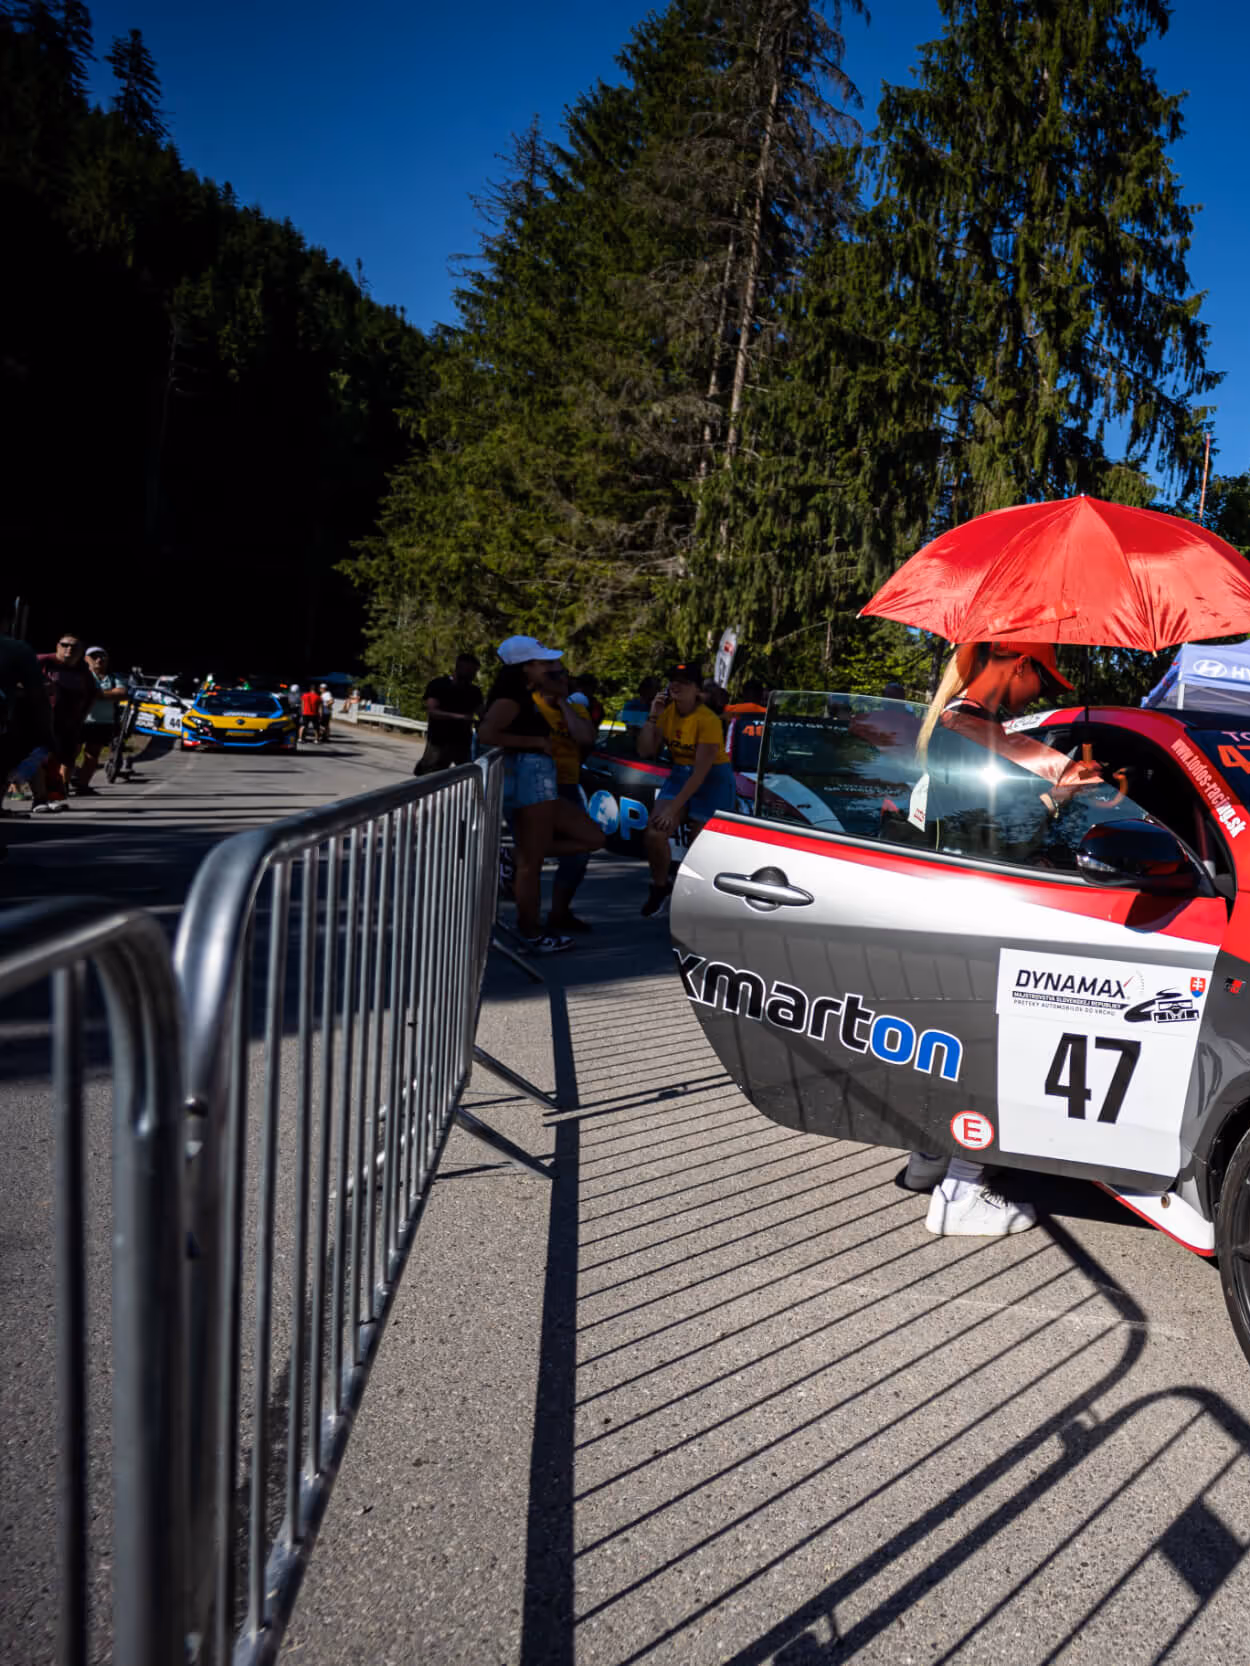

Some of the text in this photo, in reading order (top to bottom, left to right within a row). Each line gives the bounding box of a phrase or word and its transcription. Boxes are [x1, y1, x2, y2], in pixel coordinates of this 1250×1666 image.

[169, 717, 181, 729] 44
[1015, 969, 1126, 1000] DYNAMAX
[1044, 1031, 1142, 1125] 47
[963, 1118, 982, 1142] E
